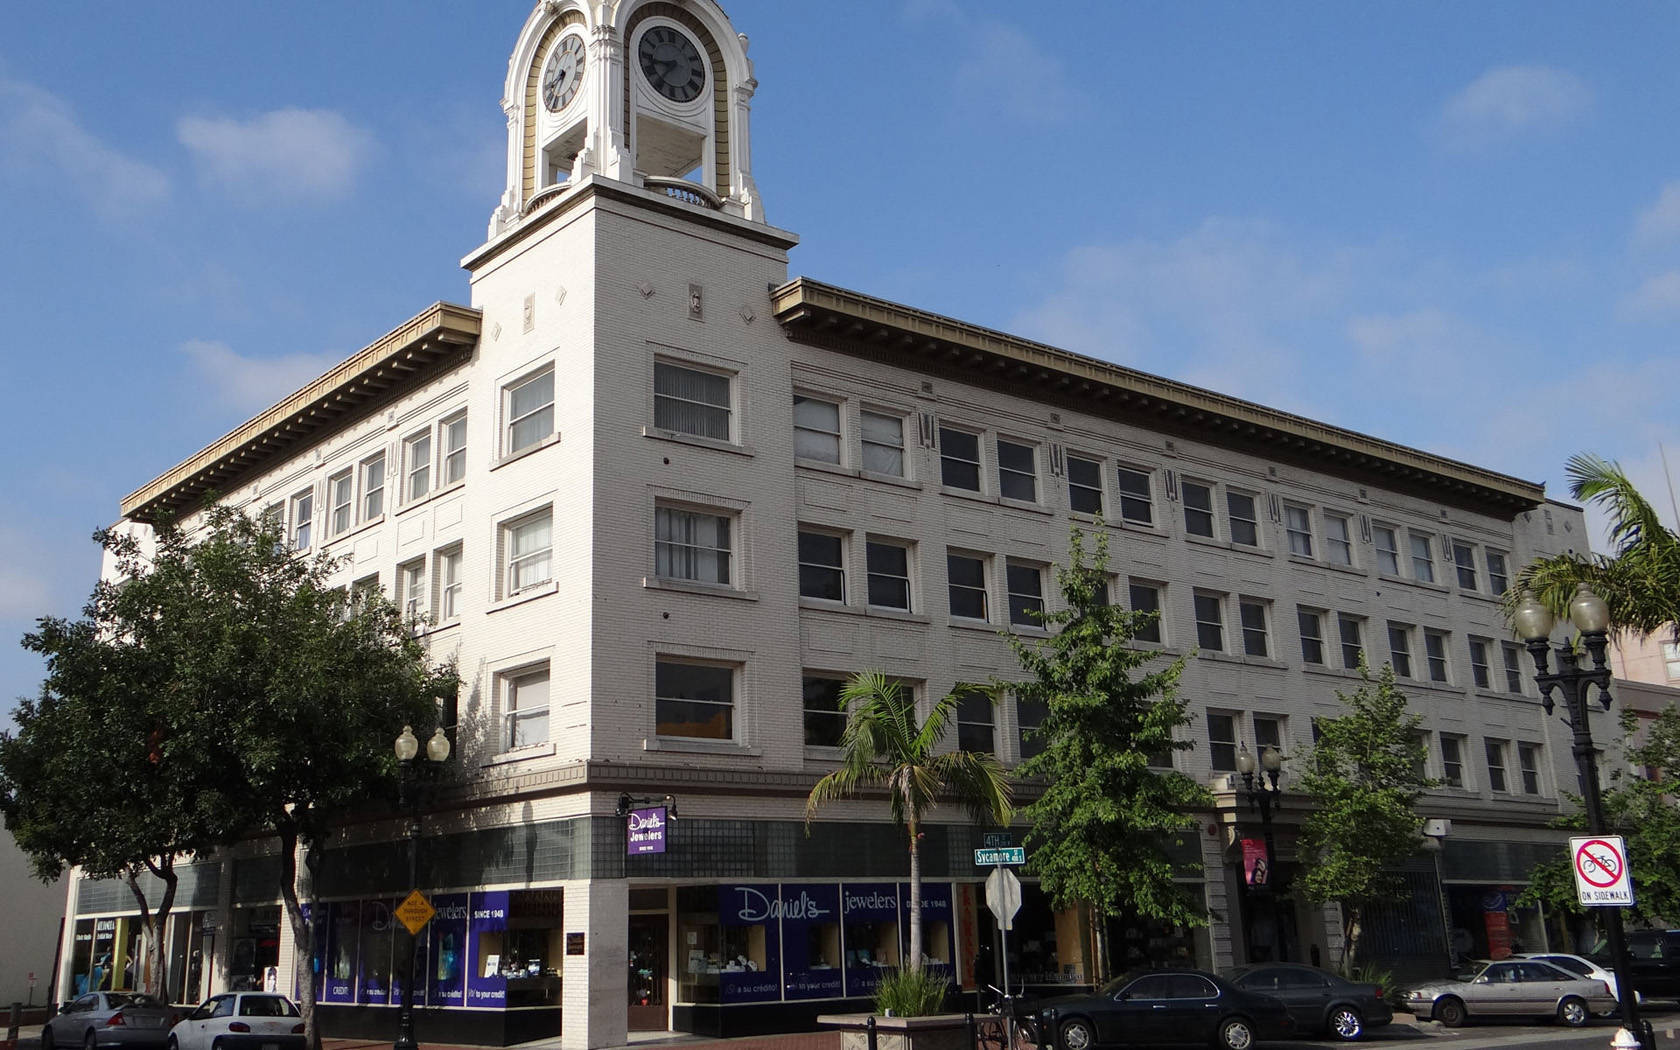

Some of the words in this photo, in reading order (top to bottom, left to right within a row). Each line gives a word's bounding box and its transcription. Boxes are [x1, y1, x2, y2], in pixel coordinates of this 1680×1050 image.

[628, 813, 665, 831] Daniel's
[630, 831, 662, 842] Jewelers
[986, 835, 1000, 846] 4TH
[977, 851, 1010, 863] Sycamore
[1582, 891, 1591, 900] ON
[1594, 891, 1629, 900] SIDEWALK
[735, 887, 830, 921] Daniel's
[844, 891, 897, 914] jewelers
